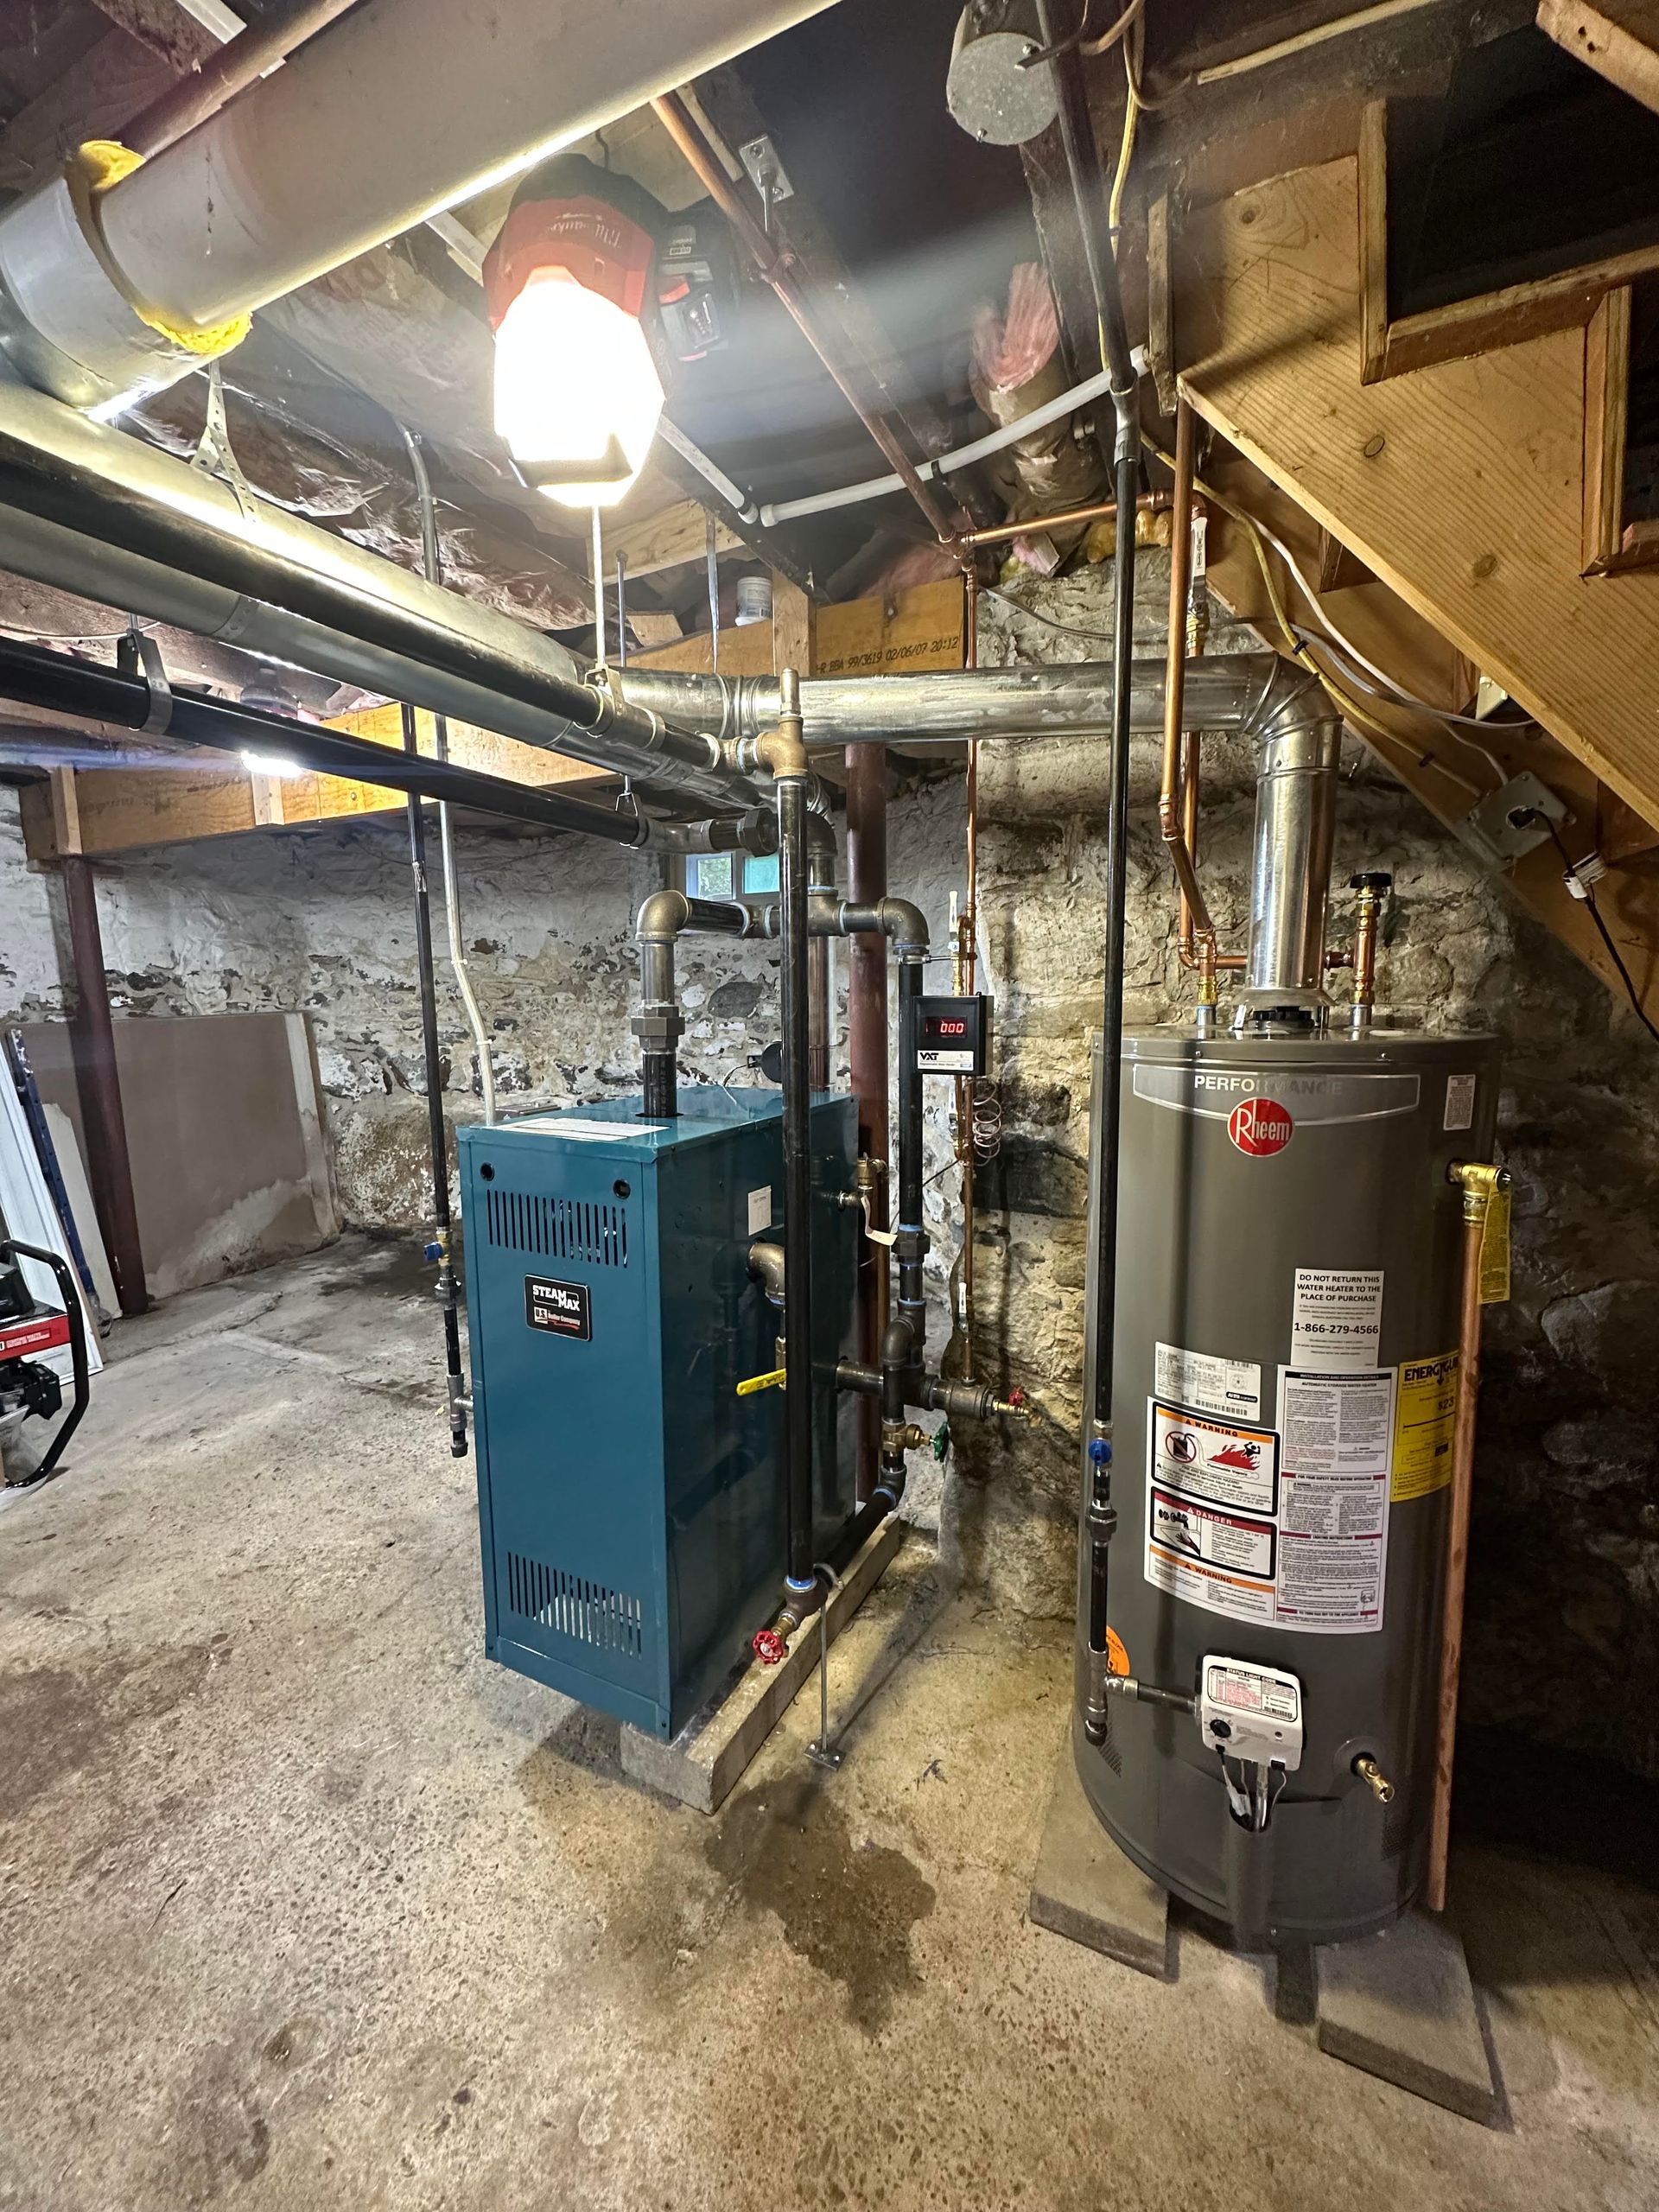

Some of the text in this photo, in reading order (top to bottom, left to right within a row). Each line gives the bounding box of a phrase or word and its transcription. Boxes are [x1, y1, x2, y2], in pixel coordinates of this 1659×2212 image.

[848, 650, 883, 669] 99/3619
[885, 642, 928, 662] 02/06/07
[931, 636, 959, 653] 20:12
[1194, 1075, 1343, 1095] PERFORMANCE
[1236, 1099, 1290, 1147] Rheem
[532, 1284, 567, 1300] STEAM
[557, 1298, 580, 1312] MAX
[1294, 1322, 1379, 1334] 1-866-279-4566
[1194, 1421, 1238, 1438] WARNING
[1196, 1510, 1232, 1526] DANGER
[1195, 1567, 1232, 1584] WARNING
